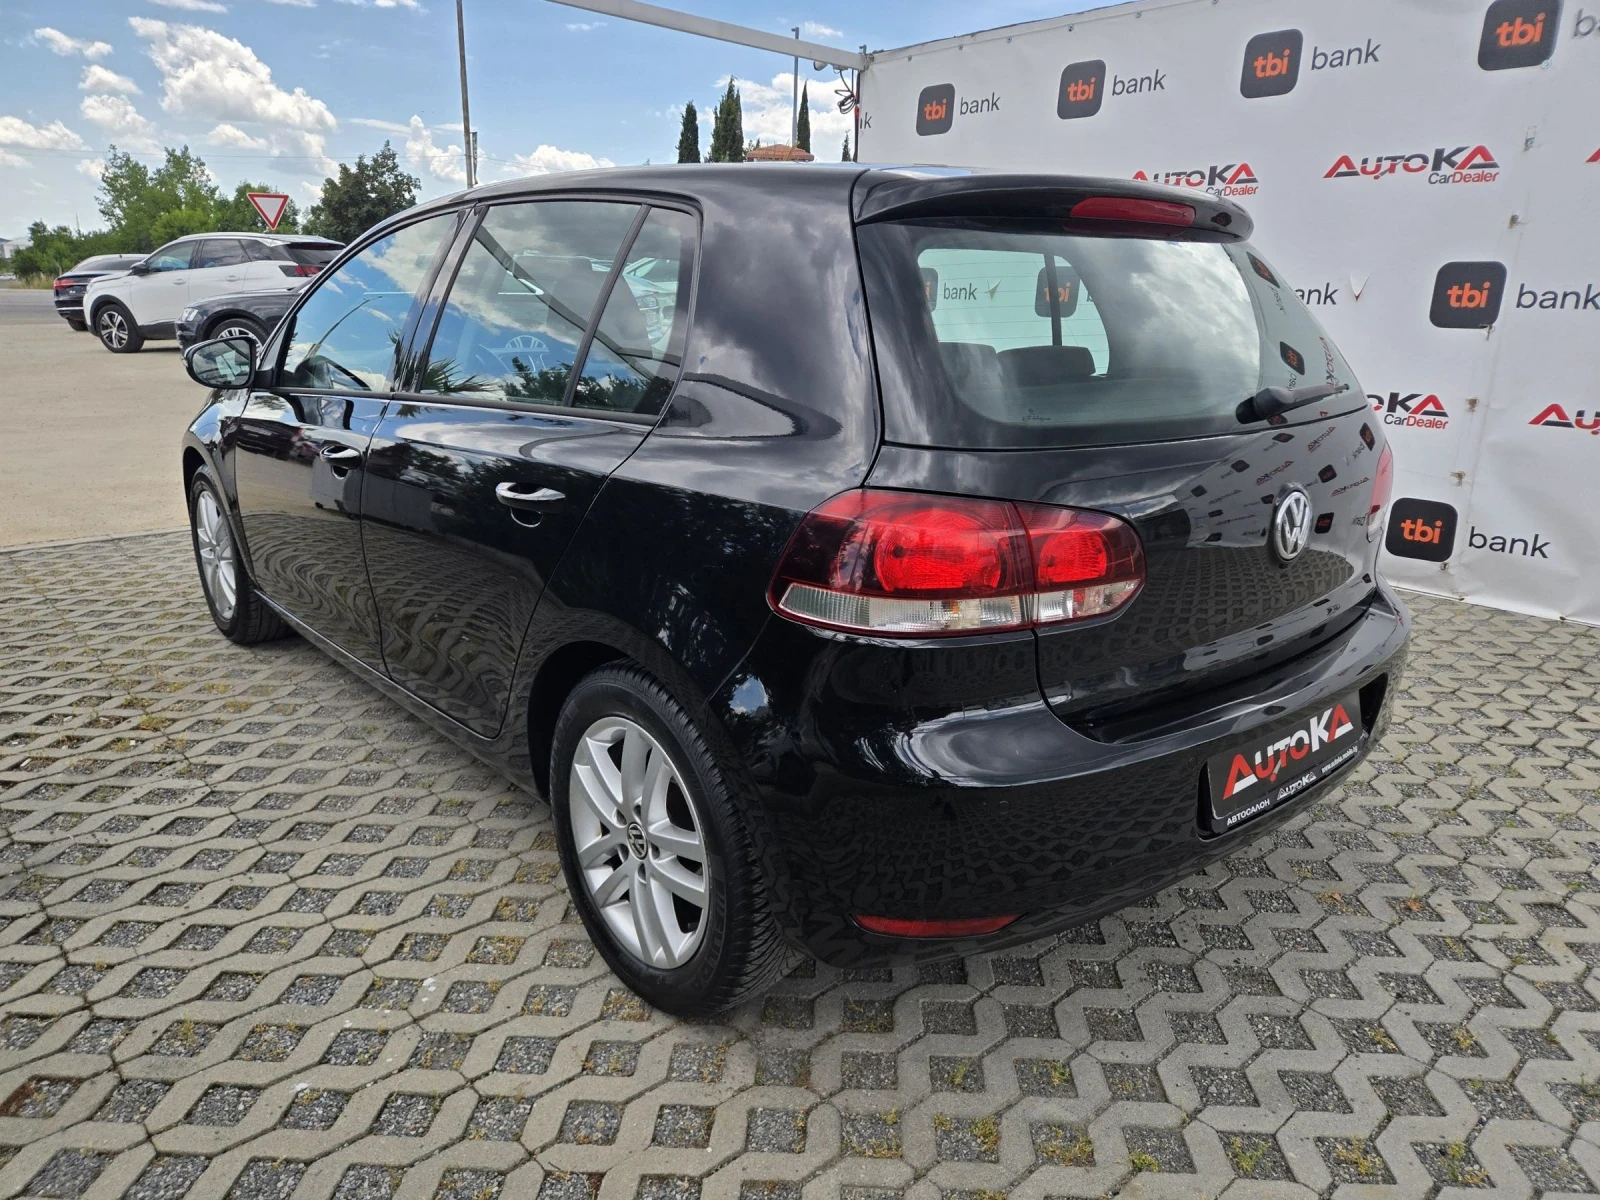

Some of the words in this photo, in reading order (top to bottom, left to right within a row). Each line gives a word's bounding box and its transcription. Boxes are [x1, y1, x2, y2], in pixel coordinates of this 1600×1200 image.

[1496, 12, 1546, 47] tbi
[1254, 48, 1291, 79] tbi
[1311, 38, 1381, 71] bank
[1067, 77, 1096, 103] tbi
[1111, 69, 1167, 97] bank
[924, 98, 947, 121] tbi
[959, 94, 1001, 116] bank
[1428, 170, 1500, 185] CarDealer
[943, 282, 977, 301] bank
[1294, 282, 1340, 306] ank
[1447, 281, 1490, 309] tbi
[1516, 283, 1600, 310] bank
[1384, 413, 1449, 430] CarDealer
[1400, 518, 1443, 545] tbi
[1469, 526, 1551, 559] bank
[1226, 798, 1271, 827] АВТОСАЛОН
